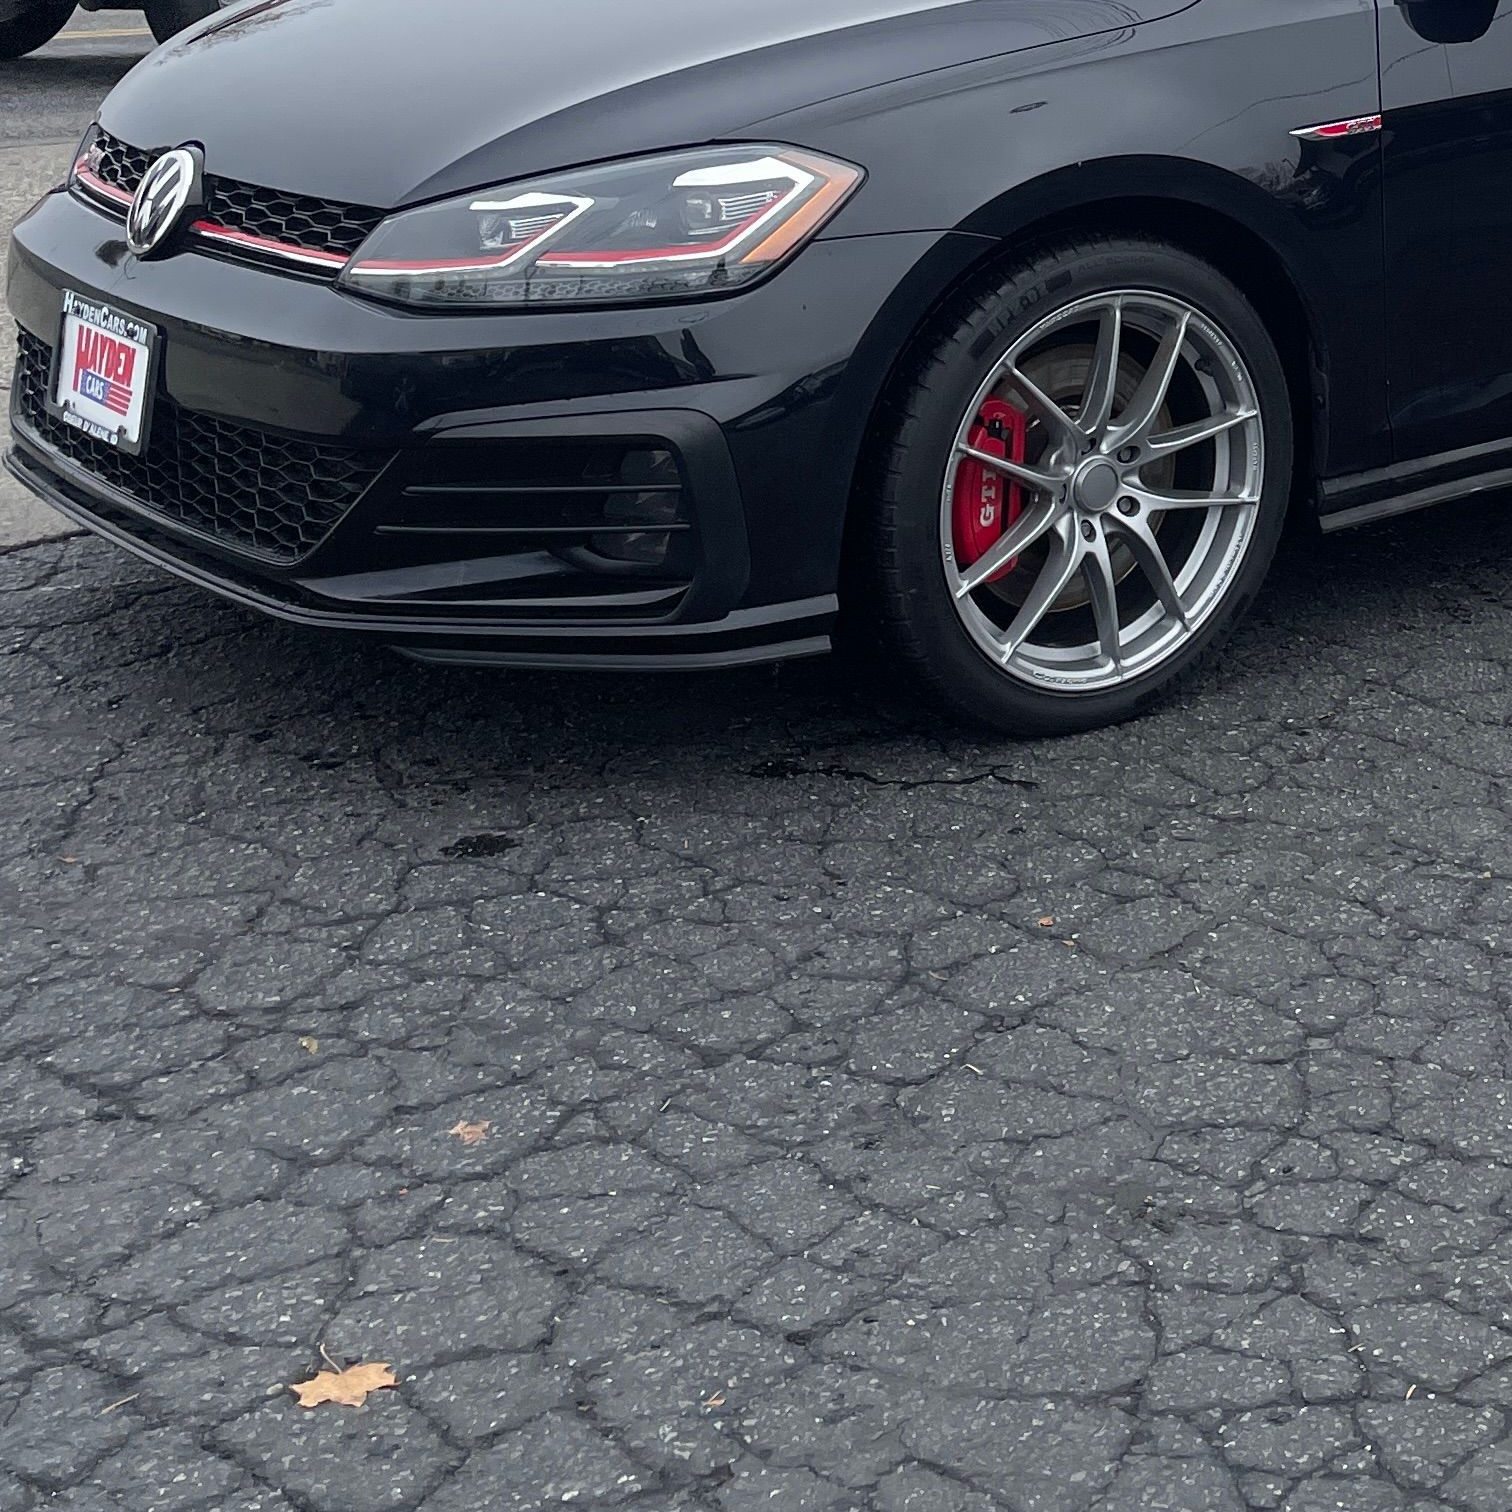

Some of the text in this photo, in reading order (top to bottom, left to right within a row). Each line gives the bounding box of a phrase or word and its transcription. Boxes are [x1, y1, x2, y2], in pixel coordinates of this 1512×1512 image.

[72, 324, 137, 392] HAYDEN
[85, 375, 105, 401] CARS
[981, 469, 996, 527] GTI
